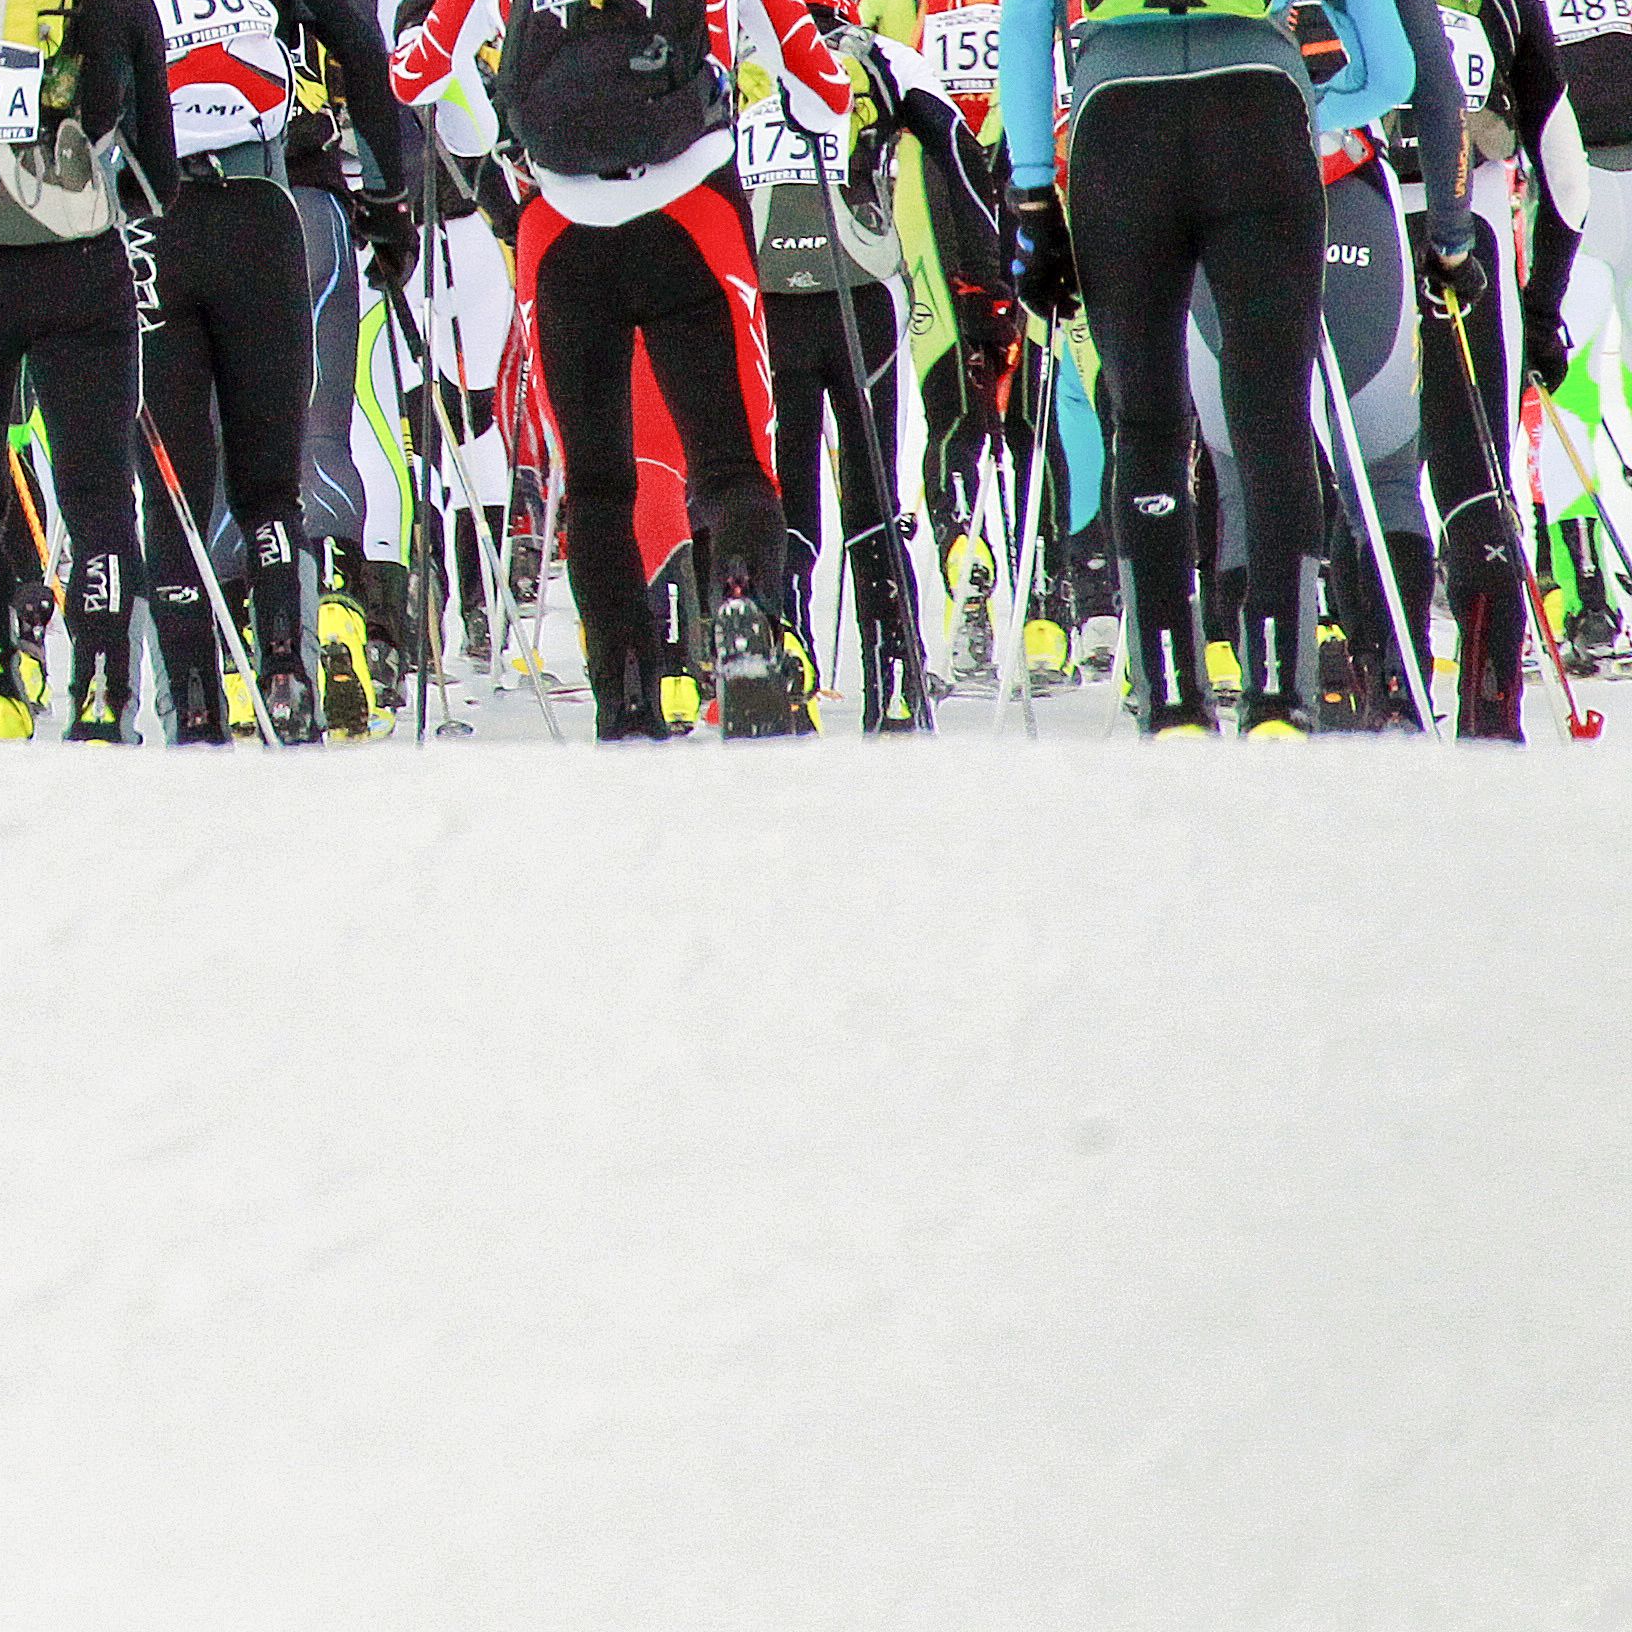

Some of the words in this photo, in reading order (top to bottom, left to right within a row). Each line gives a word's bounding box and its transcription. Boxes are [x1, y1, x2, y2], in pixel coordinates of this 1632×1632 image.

[936, 30, 1000, 71] 158
[1468, 53, 1484, 87] B
[8, 87, 29, 117] A
[822, 133, 839, 161] B
[770, 235, 828, 250] CAMP
